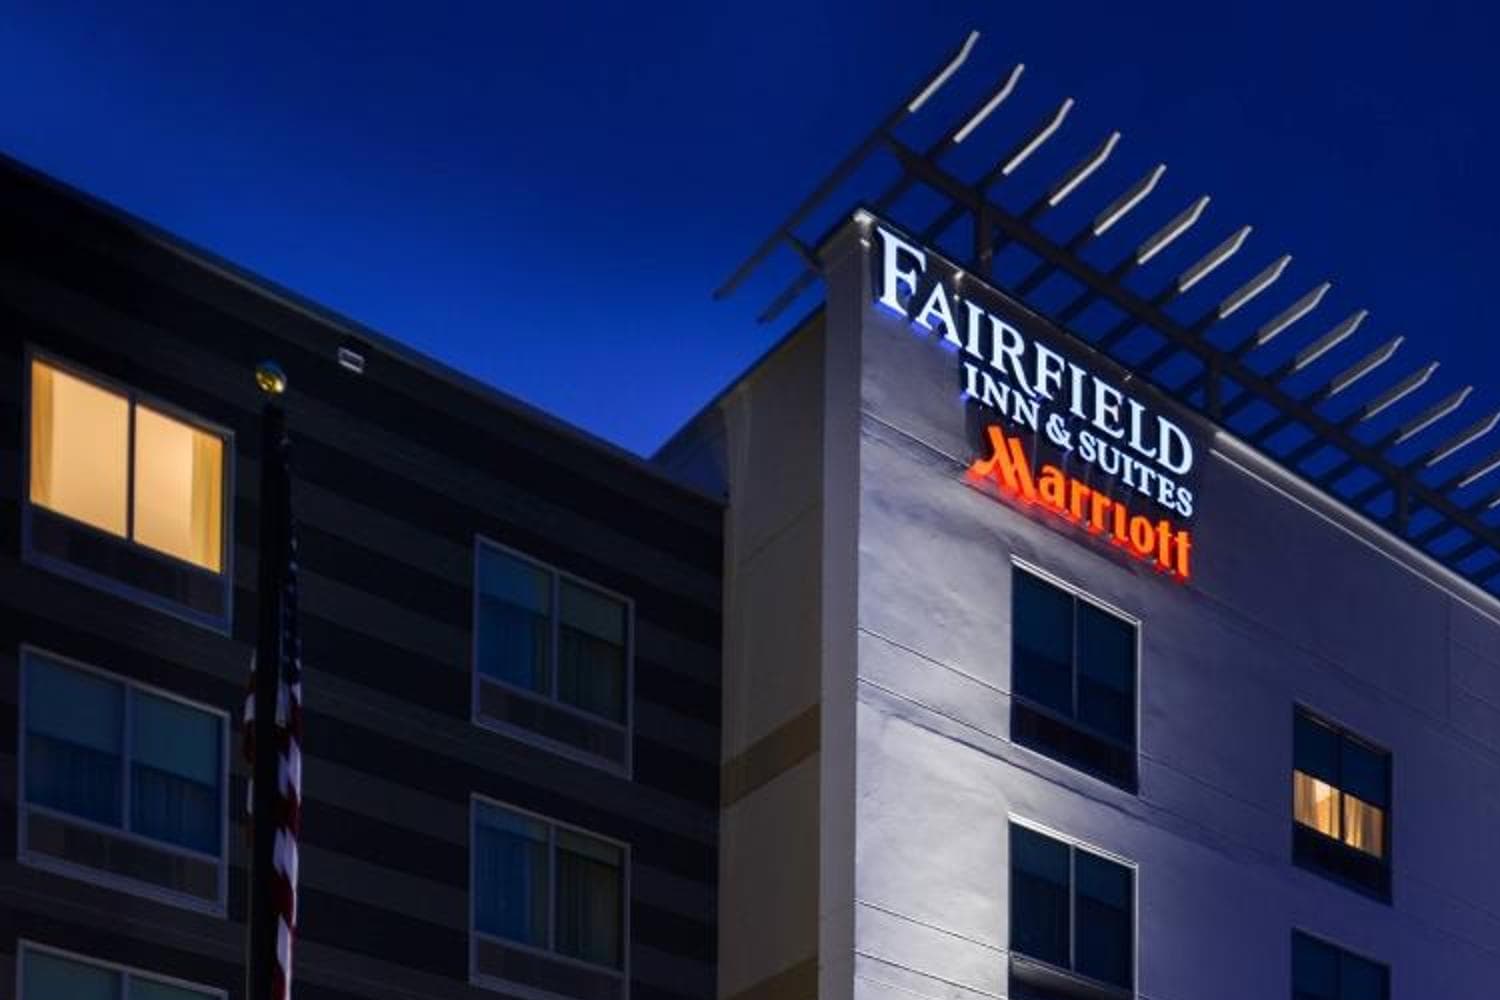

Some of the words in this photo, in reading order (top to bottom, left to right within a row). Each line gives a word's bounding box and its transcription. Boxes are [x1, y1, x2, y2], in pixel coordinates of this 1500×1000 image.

[877, 225, 1194, 476] FAIRFIELD
[963, 362, 1040, 432] INN
[1045, 412, 1074, 450] &
[1079, 430, 1194, 518] SUITES
[968, 425, 1191, 578] Marriott
